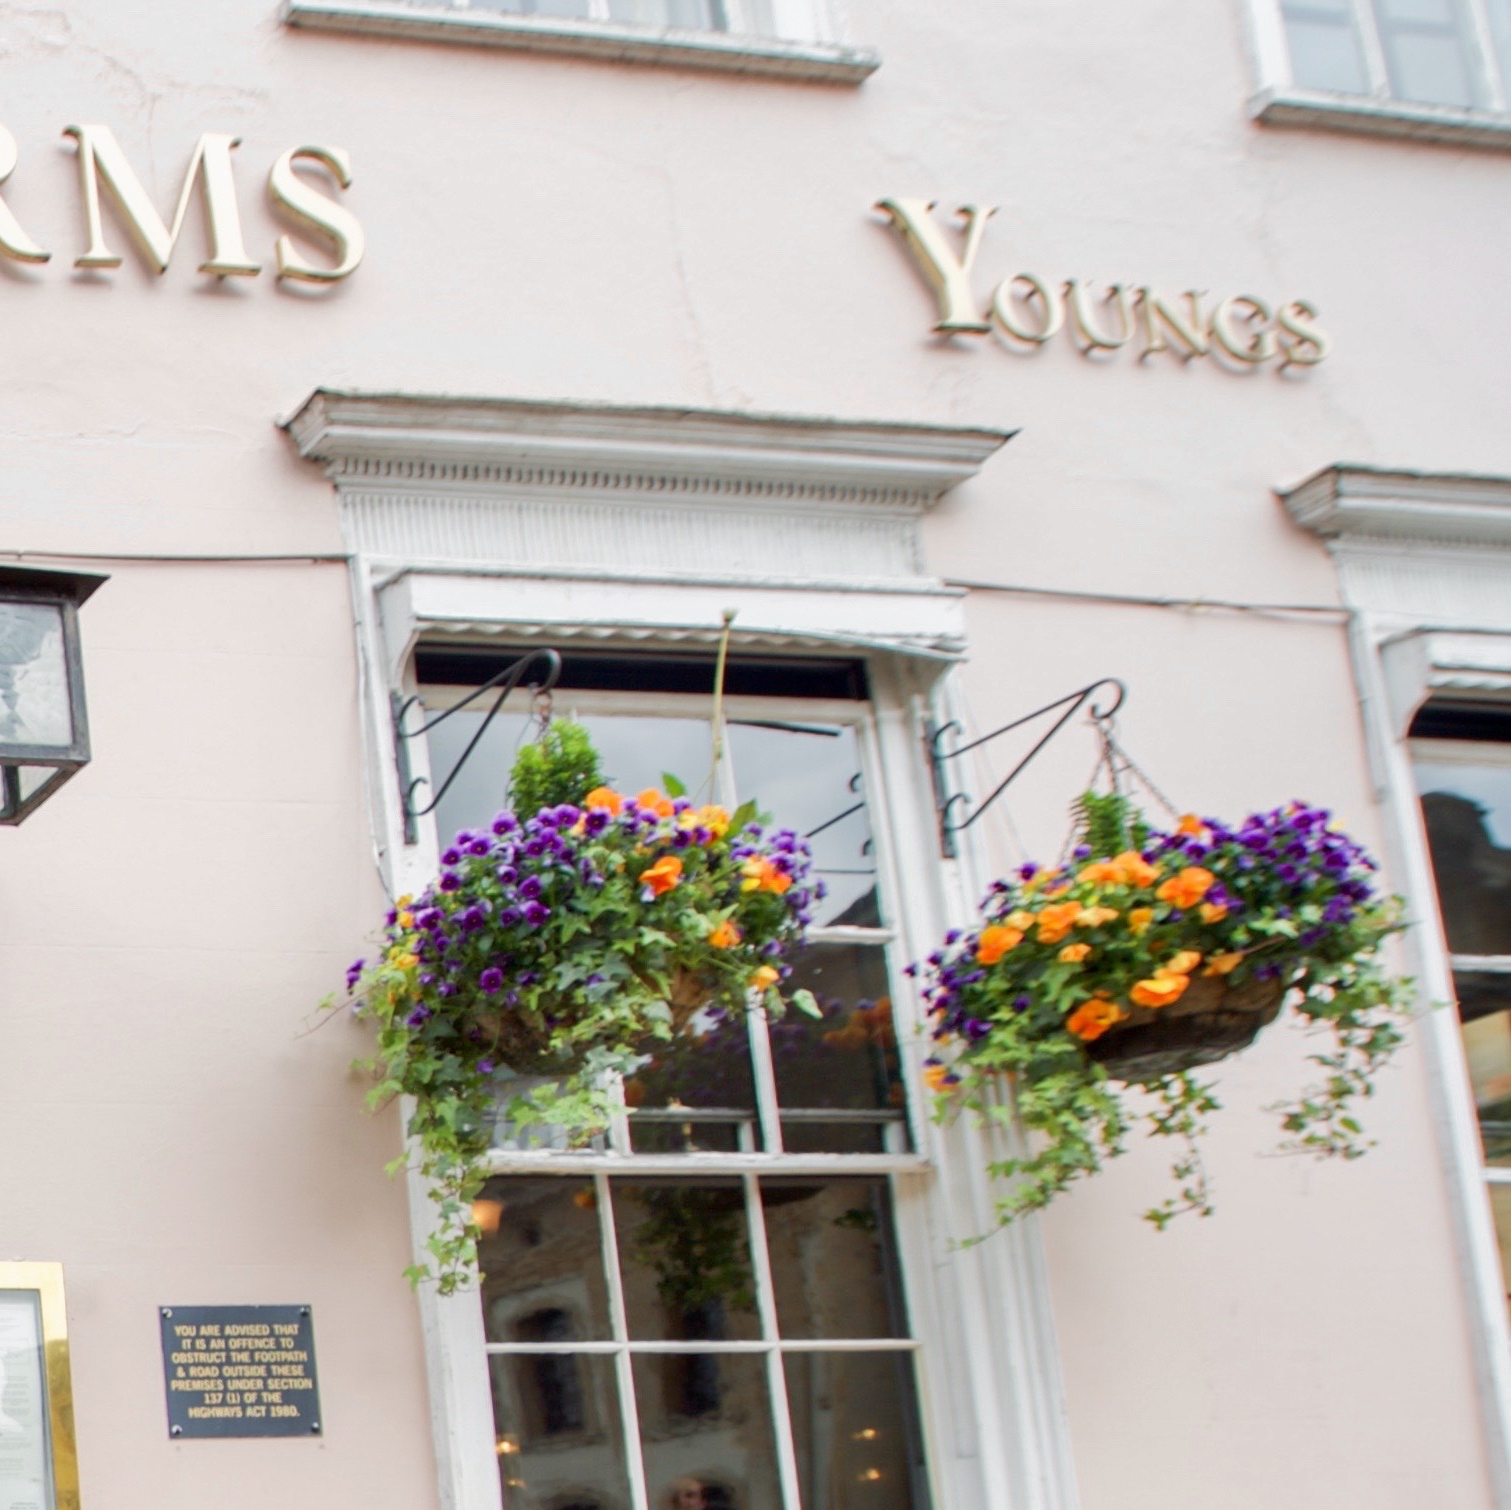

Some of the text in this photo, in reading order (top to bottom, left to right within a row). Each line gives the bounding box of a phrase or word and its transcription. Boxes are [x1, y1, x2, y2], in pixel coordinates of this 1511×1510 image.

[174, 1324, 299, 1336] YOU ARE ADVISED THAT
[182, 1339, 294, 1349] IT IS AN OFFENCE TO
[171, 1352, 307, 1363] OBSTRUCT THE FOOTPATH
[176, 1365, 304, 1377] & ROAD OUTSIDE THESE
[171, 1379, 312, 1390] PREMISES UNDER SECTION
[204, 1392, 282, 1404] 137 (1) OF THE
[188, 1406, 300, 1418] HIGHWAYS ACT 1980.
